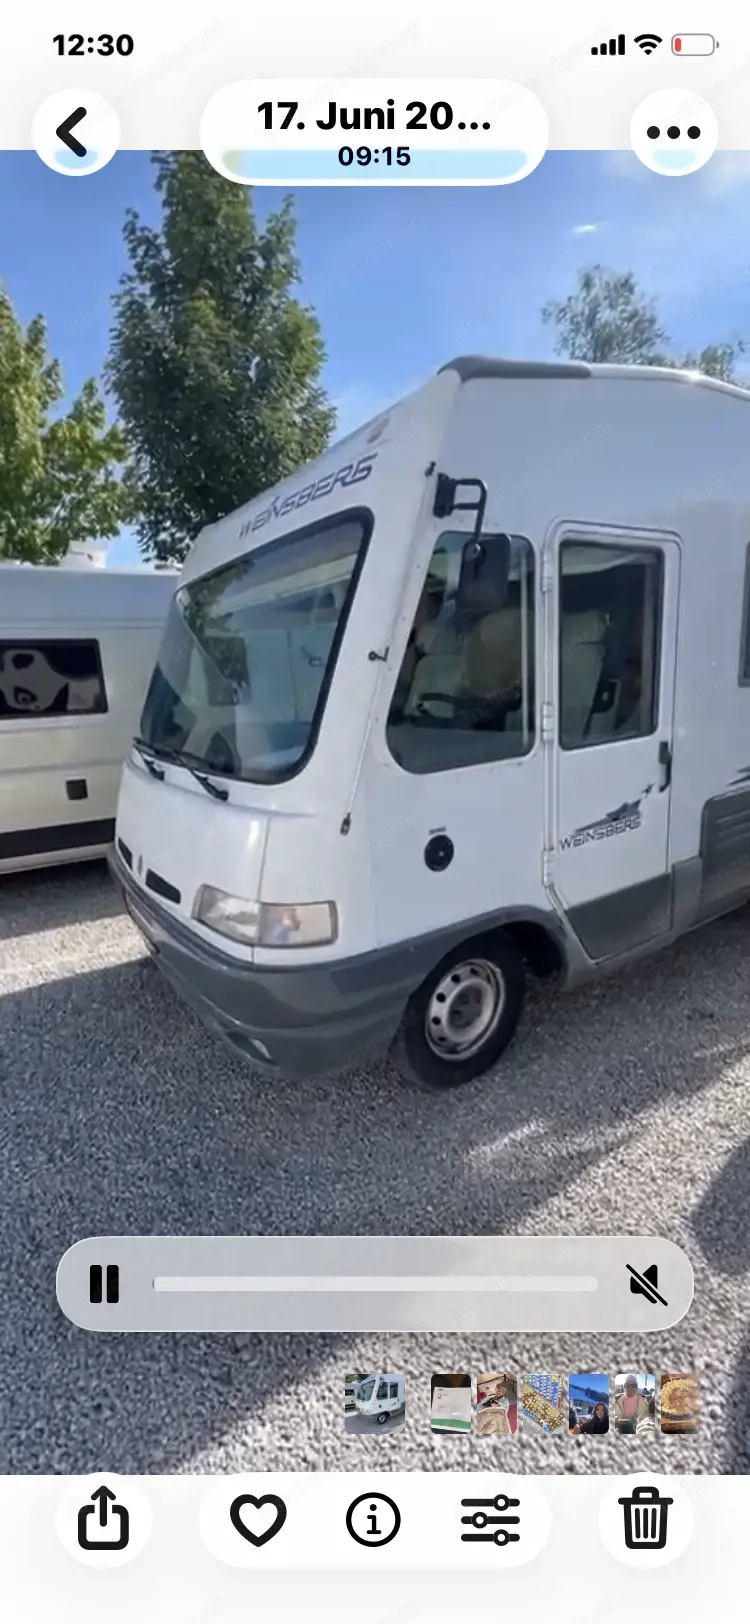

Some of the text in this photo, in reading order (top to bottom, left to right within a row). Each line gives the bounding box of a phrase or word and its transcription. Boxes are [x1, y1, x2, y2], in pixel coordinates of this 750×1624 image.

[52, 33, 134, 57] 12:30
[257, 101, 305, 130] 17.
[315, 98, 395, 131] Juni
[337, 145, 412, 167] 09:15
[238, 452, 378, 540] WEINSBERG
[559, 815, 642, 851] WEINSBERG
